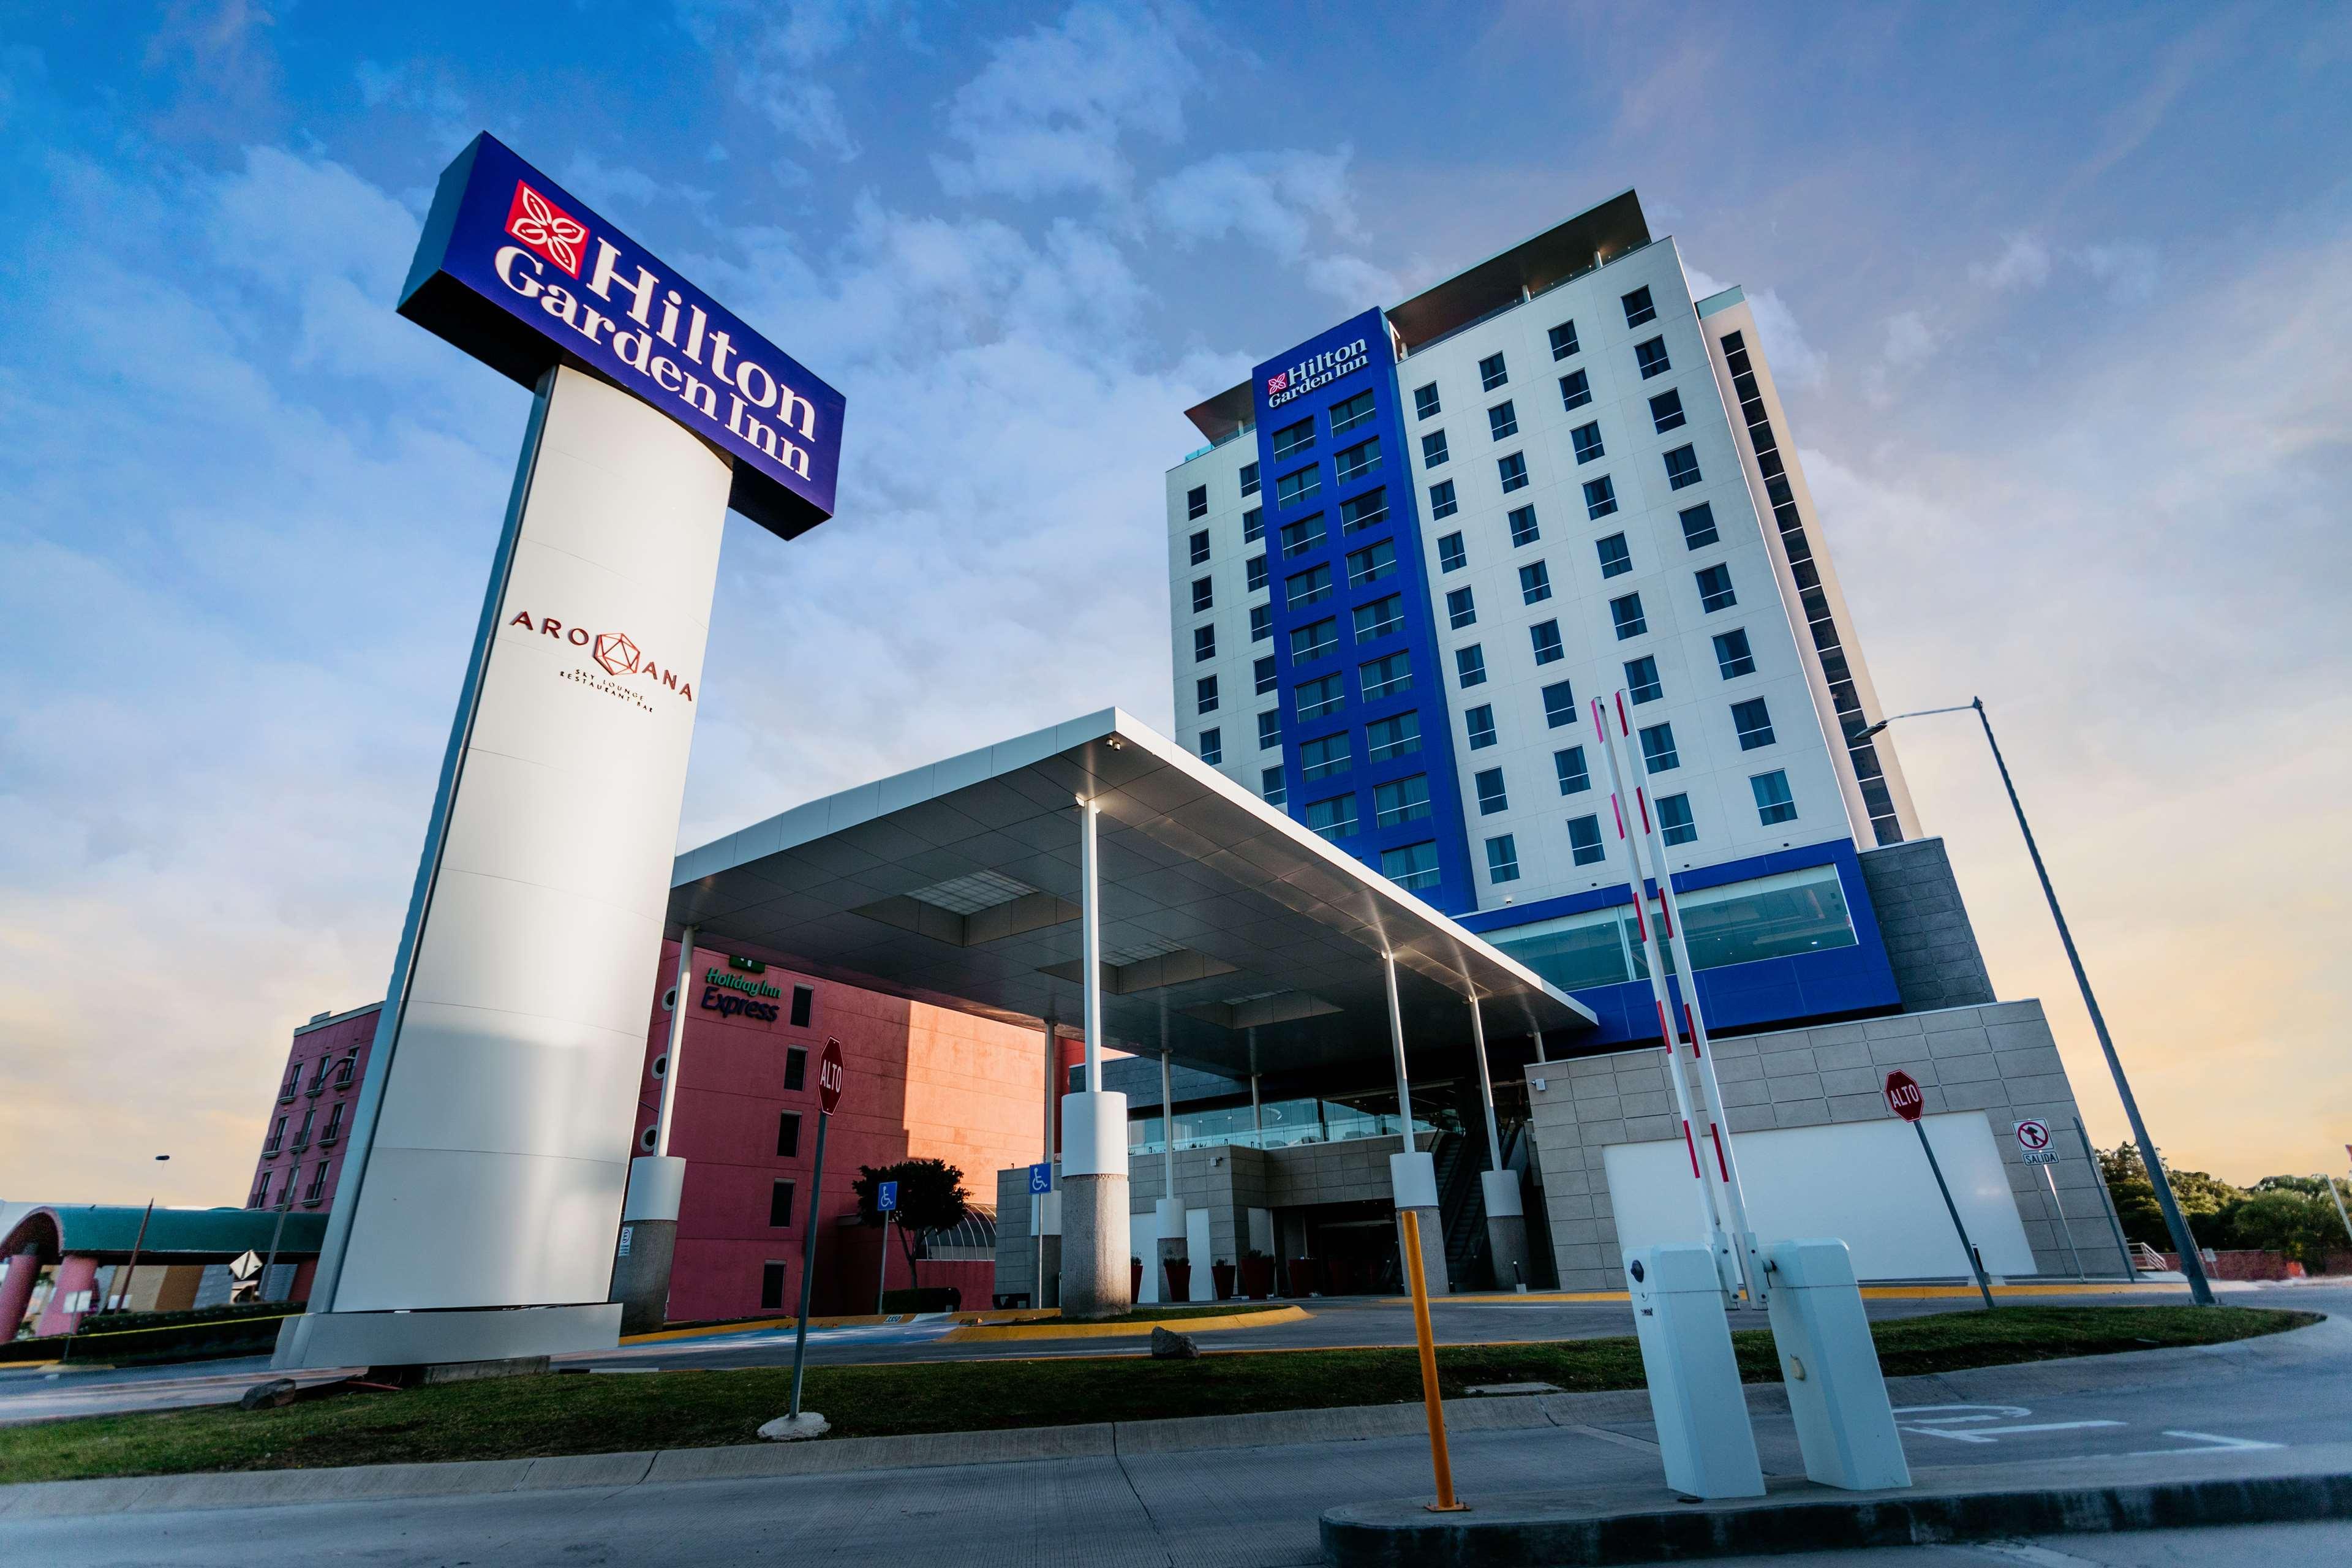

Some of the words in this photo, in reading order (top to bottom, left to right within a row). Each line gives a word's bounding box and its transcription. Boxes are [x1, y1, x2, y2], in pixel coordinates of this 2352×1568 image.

[586, 237, 816, 442] Hilton
[495, 246, 718, 421] Garden
[725, 393, 812, 481] Inn
[1287, 338, 1367, 386] Hilton
[1268, 371, 1333, 408] Garden
[1335, 355, 1368, 378] Inn
[560, 671, 630, 701] RESTAURANT
[637, 701, 652, 712] BAR
[575, 669, 594, 680] SKY
[706, 968, 760, 997] Holiday
[761, 980, 782, 999] Inn
[701, 986, 780, 1022] Express
[820, 1059, 842, 1093] ALTO
[1890, 1084, 1920, 1108] ALTO
[2026, 1153, 2057, 1164] SALIDA
